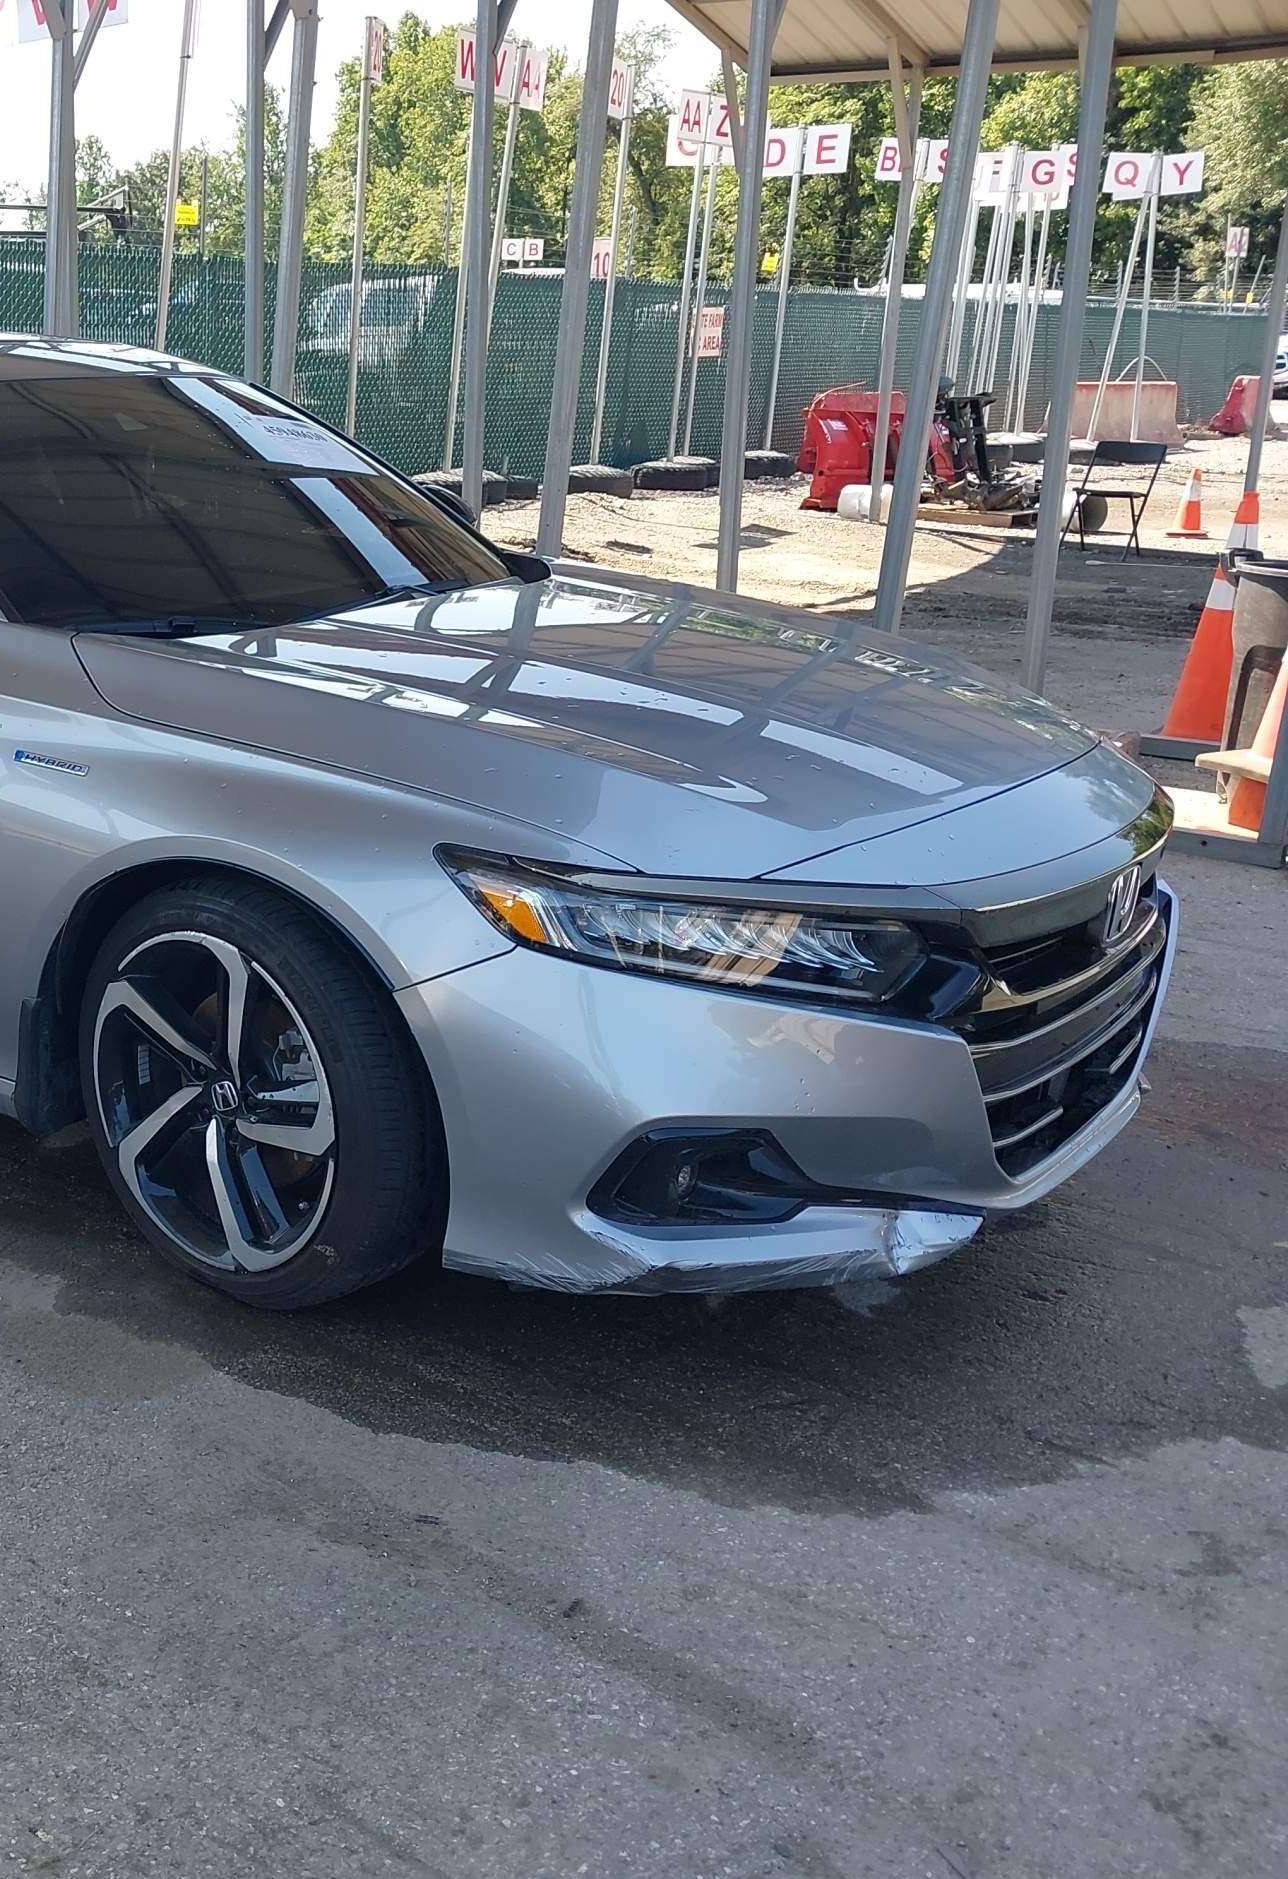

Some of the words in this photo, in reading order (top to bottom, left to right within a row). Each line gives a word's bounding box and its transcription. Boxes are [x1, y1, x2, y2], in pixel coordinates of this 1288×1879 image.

[680, 98, 702, 133] AA
[764, 138, 787, 168] D
[815, 134, 839, 164] E
[1031, 158, 1055, 185] G
[1114, 160, 1139, 188] Q
[1173, 159, 1194, 186] Y
[506, 243, 517, 256] C
[529, 243, 539, 256] B
[593, 252, 610, 278] 10
[702, 335, 720, 350] AREA
[23, 752, 83, 773] HYBRID
